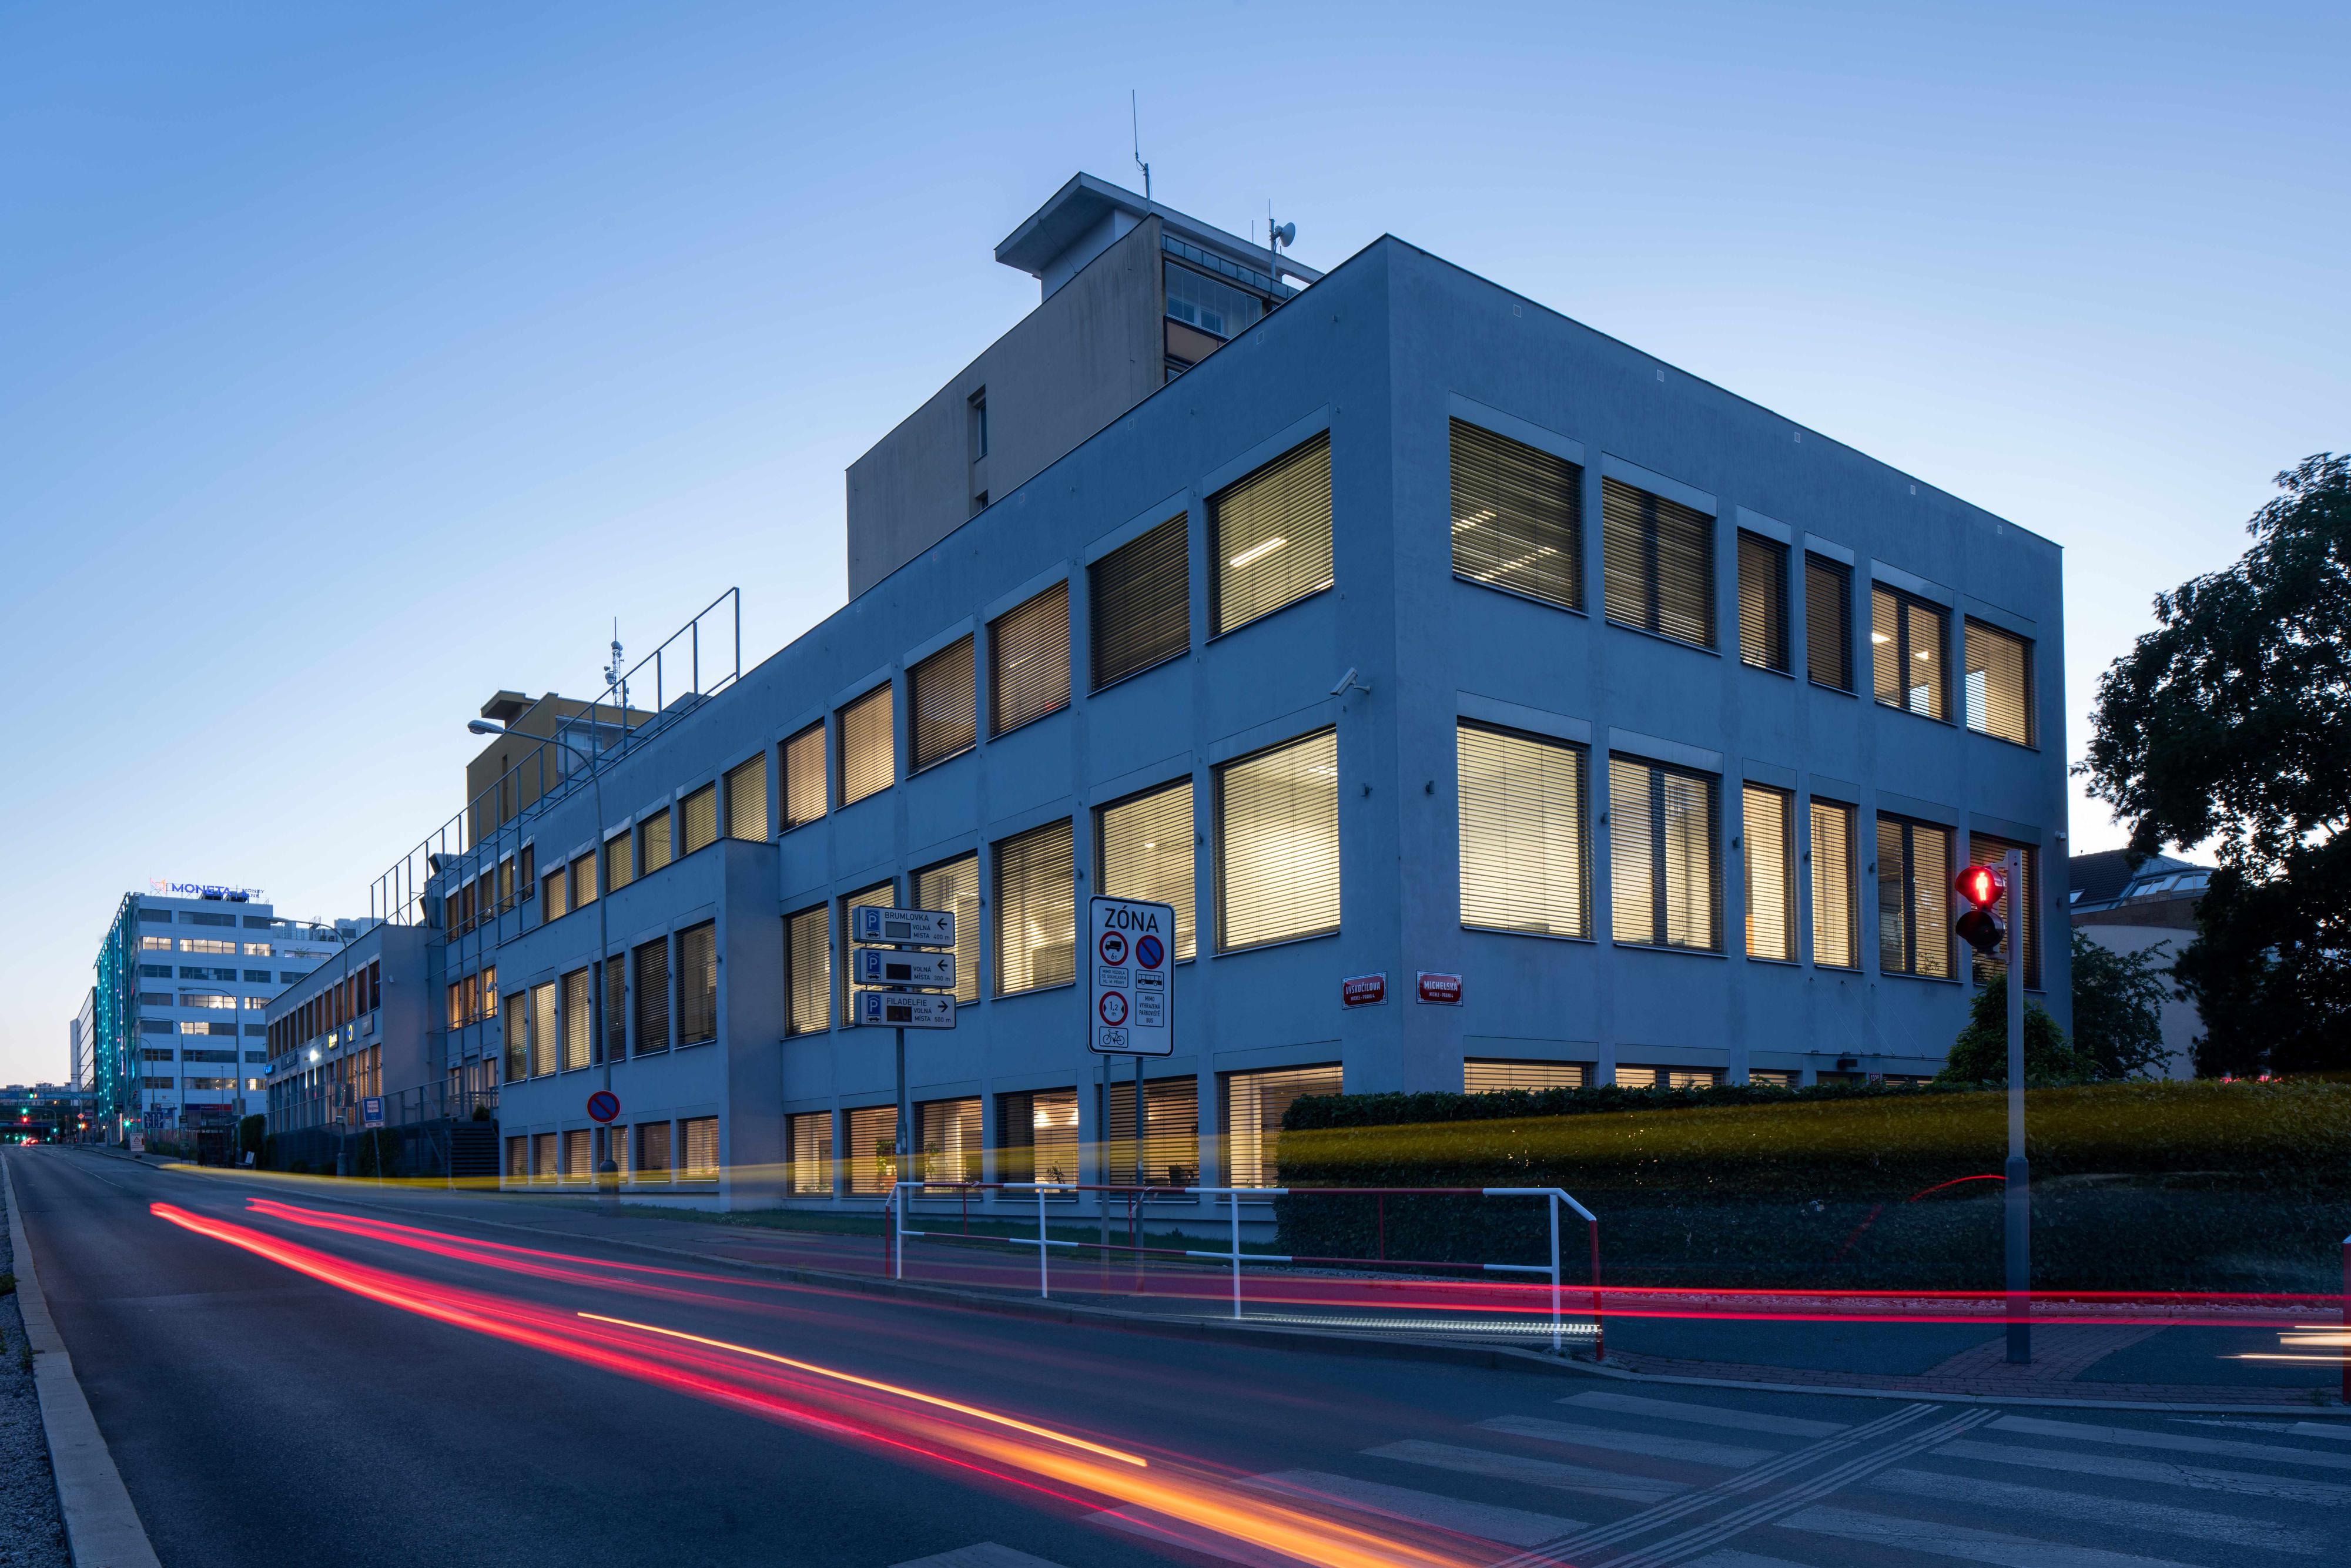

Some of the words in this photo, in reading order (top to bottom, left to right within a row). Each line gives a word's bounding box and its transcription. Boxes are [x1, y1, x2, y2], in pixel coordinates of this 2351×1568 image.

[172, 883, 233, 896] MONETA
[885, 912, 929, 922] BRUMLOVKA
[1104, 905, 1159, 933] ZÓNA
[912, 923, 931, 931] VOLNÁ
[1345, 981, 1381, 995] VYSKOČILOVA
[1424, 980, 1458, 991] MICHELSKÁ
[886, 997, 927, 1007] FILADELFIE
[1110, 1001, 1118, 1011] 1,2
